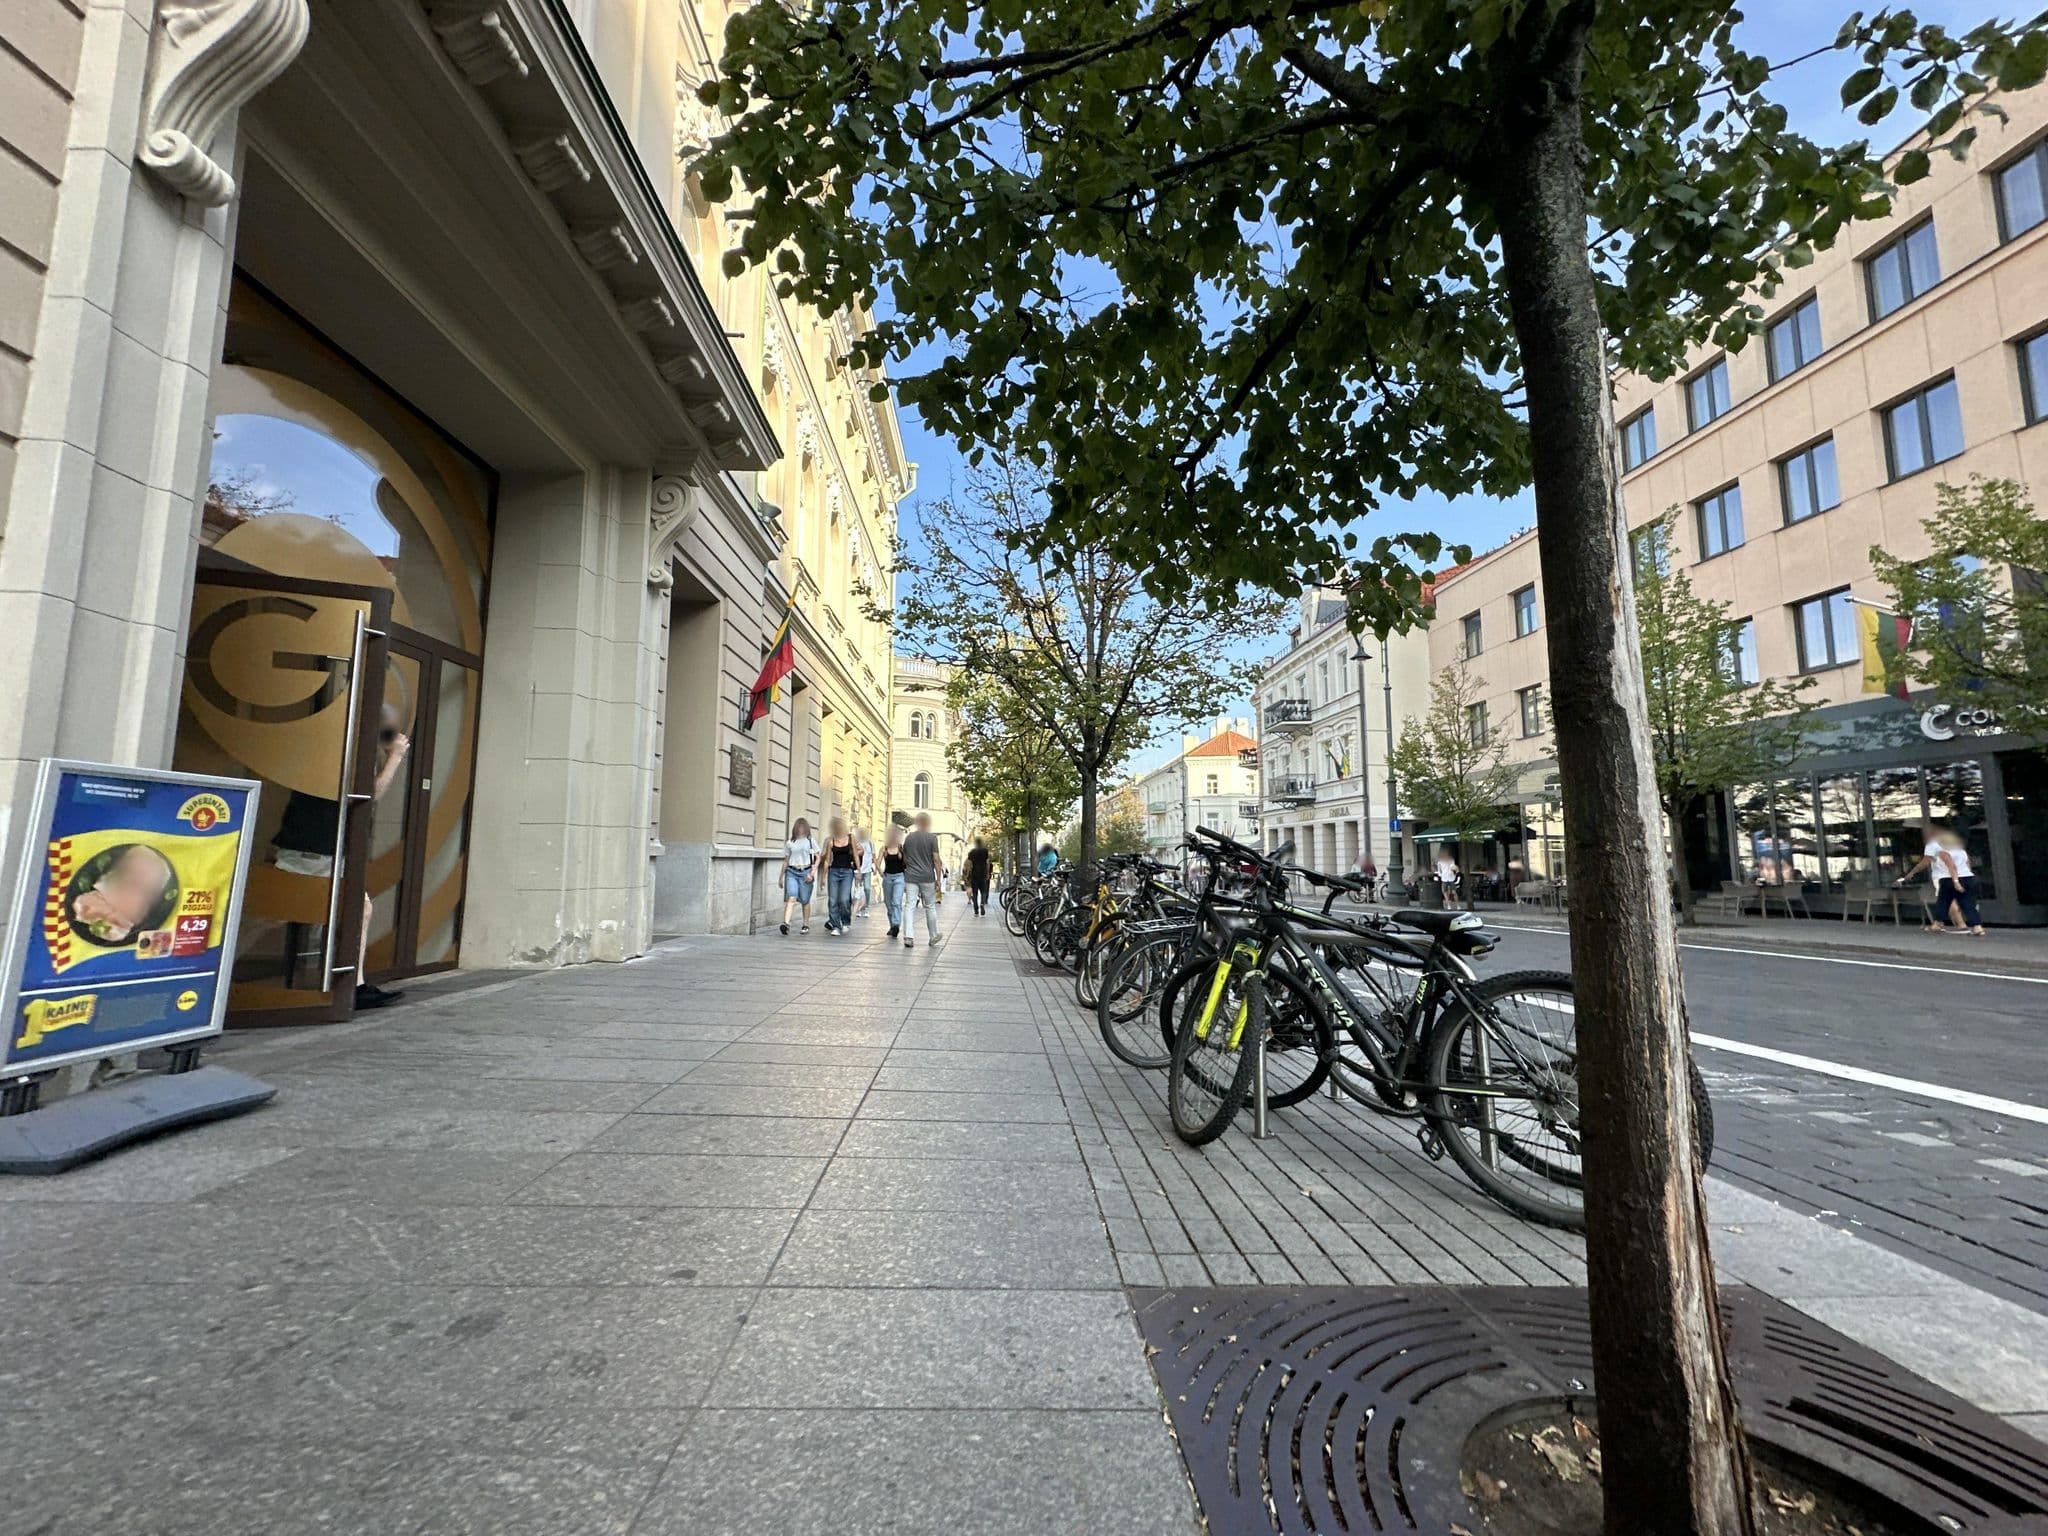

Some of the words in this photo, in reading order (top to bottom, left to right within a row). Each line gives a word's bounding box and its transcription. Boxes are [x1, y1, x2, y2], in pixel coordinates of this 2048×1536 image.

[187, 891, 211, 903] 21%
[183, 904, 212, 912] PIGIAU
[180, 920, 208, 933] 4,29
[1300, 958, 1354, 1028] ESPRIA
